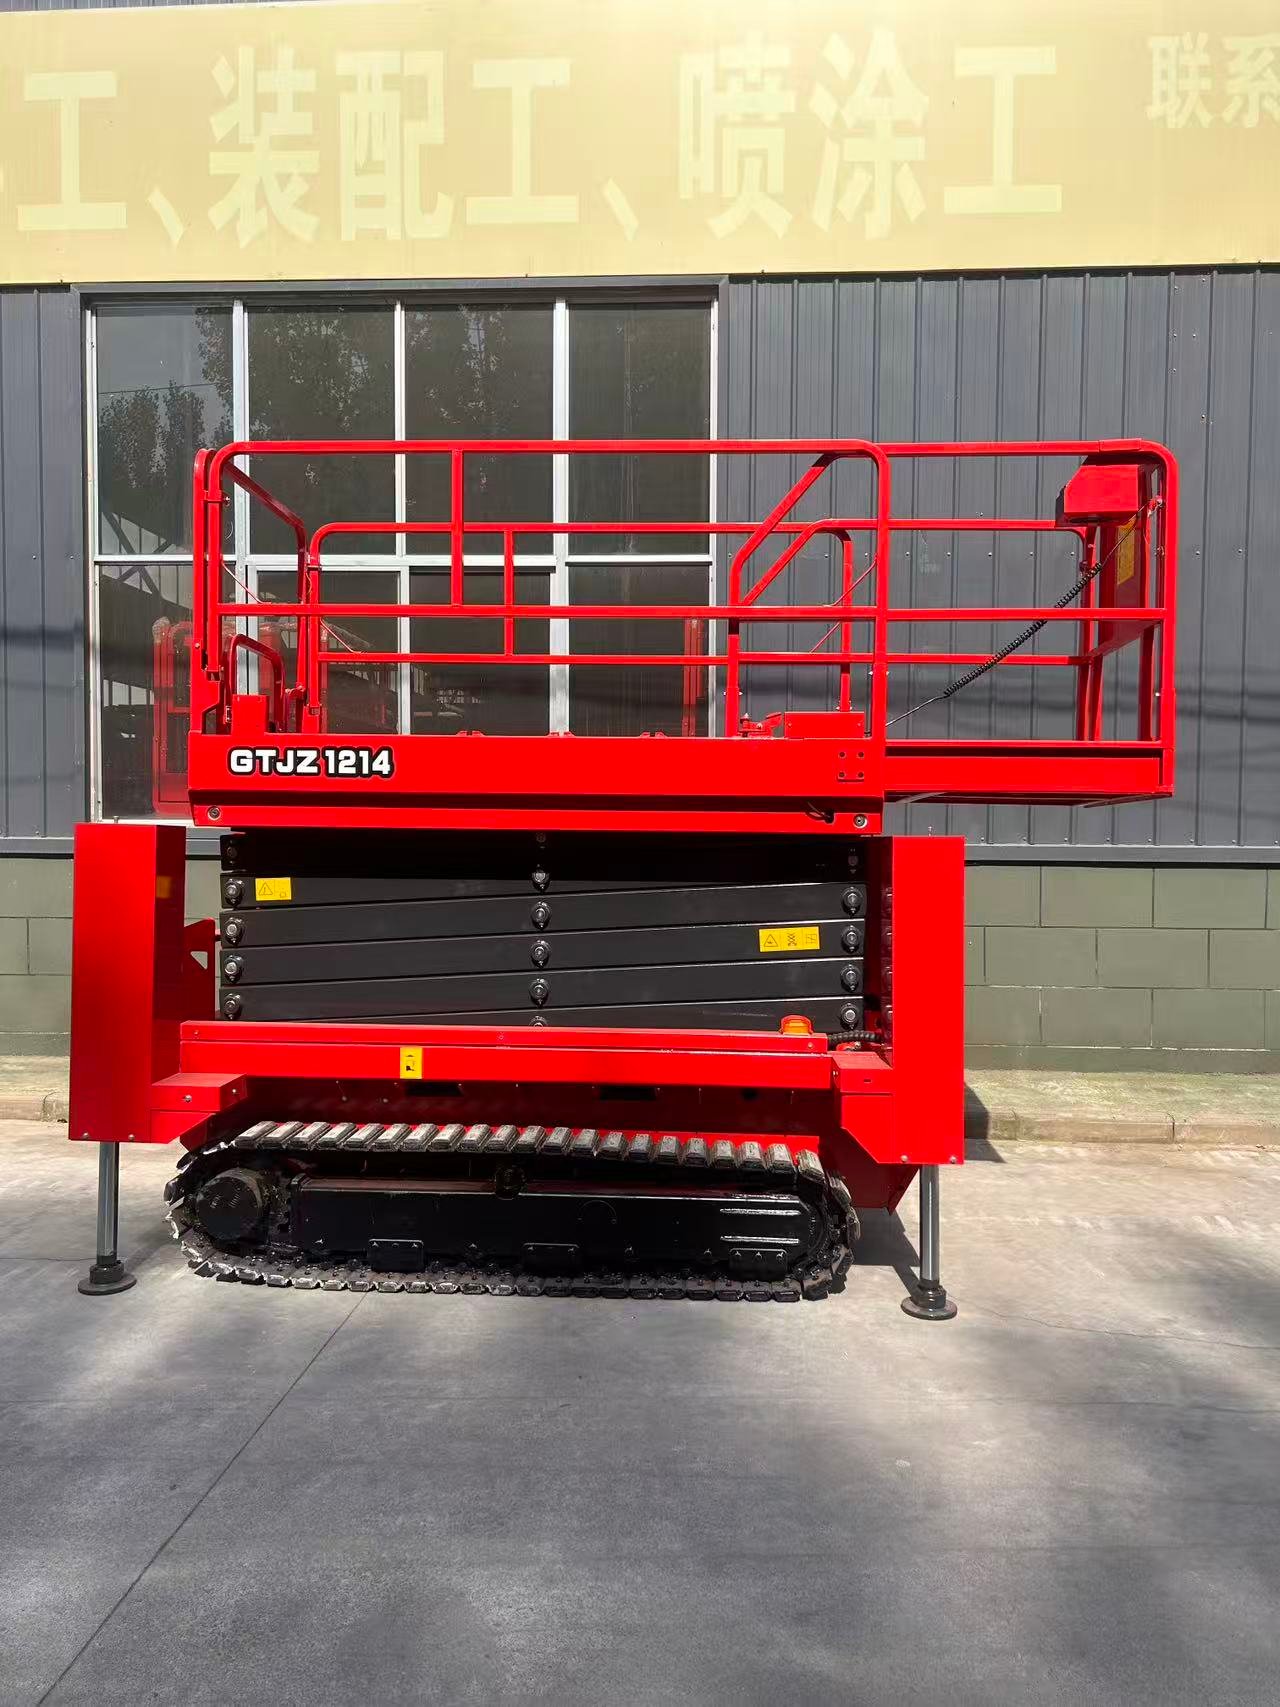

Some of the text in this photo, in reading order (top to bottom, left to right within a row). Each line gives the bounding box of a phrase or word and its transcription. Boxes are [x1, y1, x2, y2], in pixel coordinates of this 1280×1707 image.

[1146, 32, 1280, 129] 联系
[229, 748, 392, 776] GTJZ 1214
